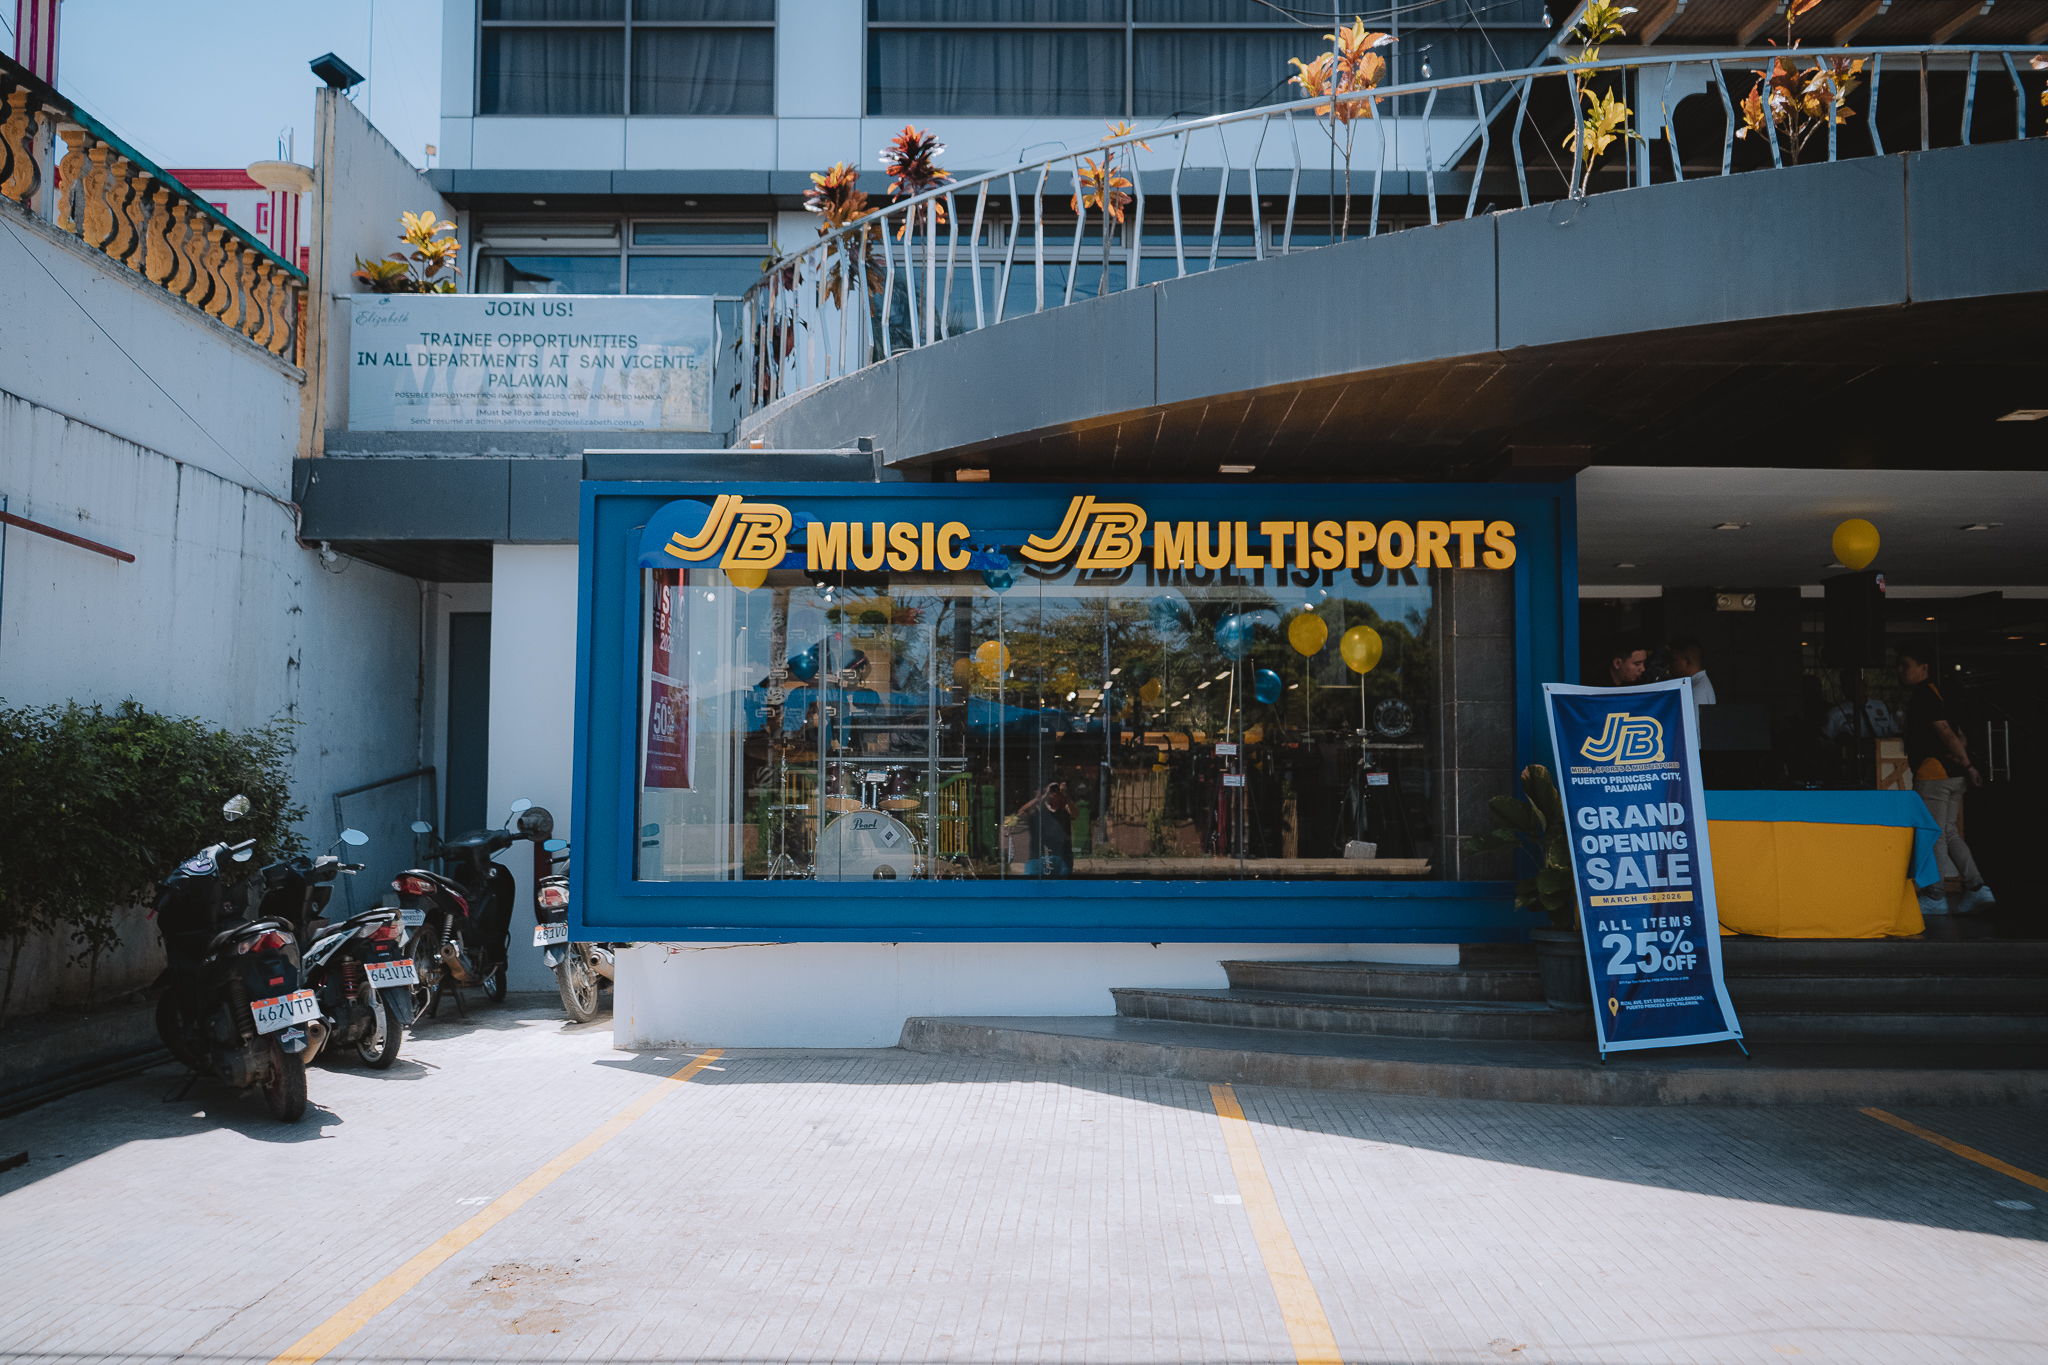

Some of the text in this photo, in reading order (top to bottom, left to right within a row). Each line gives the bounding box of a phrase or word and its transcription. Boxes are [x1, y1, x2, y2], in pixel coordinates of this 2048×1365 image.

[485, 301, 574, 317] JOIN US!
[355, 311, 410, 328] Elizabeth
[420, 332, 638, 349] TRAINEE OPPORTUNITIES
[357, 351, 700, 371] IN ALL DEPARTMENTS AT SAN VICENTE,
[488, 373, 569, 388] PALAWAN
[476, 409, 500, 417] (Must
[534, 409, 550, 417] and
[551, 410, 579, 418] above)
[664, 494, 972, 571] JB MUSIC
[1020, 495, 1517, 571] JB MULTISPORTS
[653, 702, 675, 736] 50%
[1580, 712, 1666, 766] JB
[1596, 764, 1625, 773] SPORTS
[1632, 761, 1680, 771] MULTISPORTS
[1571, 772, 1682, 785] PUERTO PRINCESA CITY,
[1604, 782, 1652, 793] PALAWAN
[850, 817, 878, 831] Pearl
[1577, 802, 1685, 830] GRAND
[1581, 830, 1688, 854] OPENING
[1586, 853, 1692, 891] SALE
[1602, 895, 1638, 904] MARCH
[1598, 915, 1692, 931] ALL ITEMS
[1602, 929, 1697, 975] 25% OFF
[371, 966, 414, 981] 641VIR
[258, 998, 313, 1022] 467VTP
